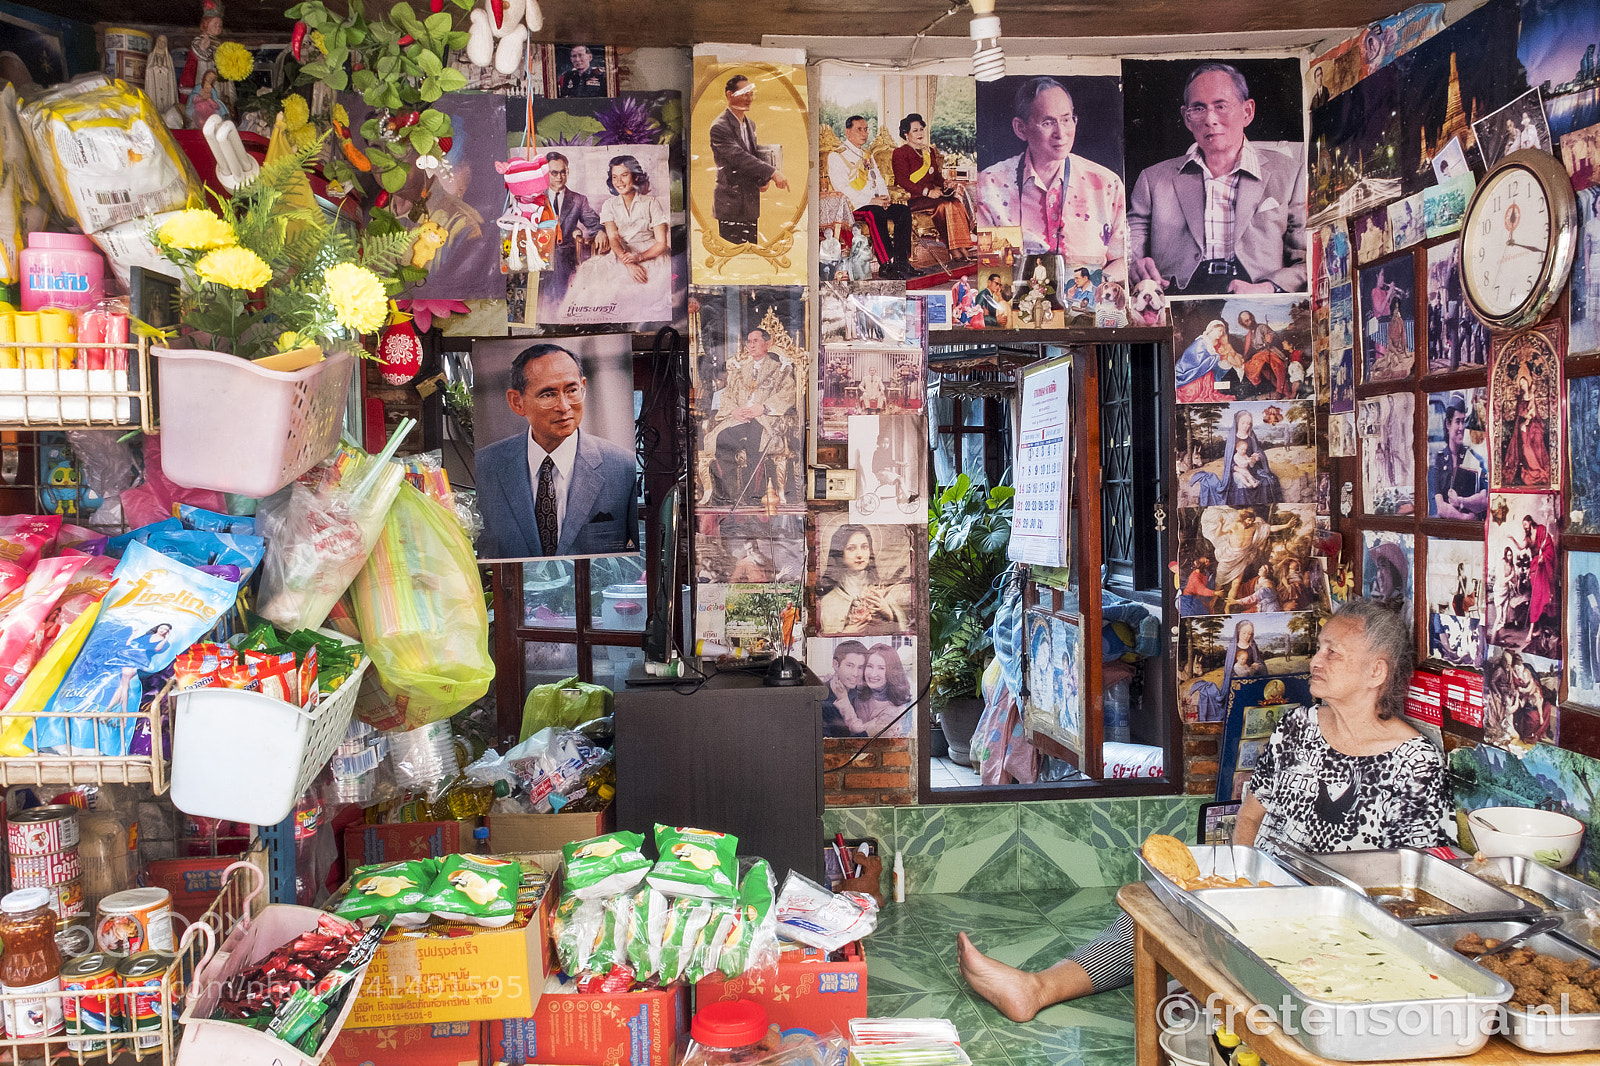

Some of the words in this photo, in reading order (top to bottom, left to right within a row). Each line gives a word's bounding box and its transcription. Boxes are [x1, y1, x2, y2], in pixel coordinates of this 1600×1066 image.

[1508, 181, 1519, 199] 12
[1482, 219, 1492, 235] 10
[1483, 271, 1490, 286] 8
